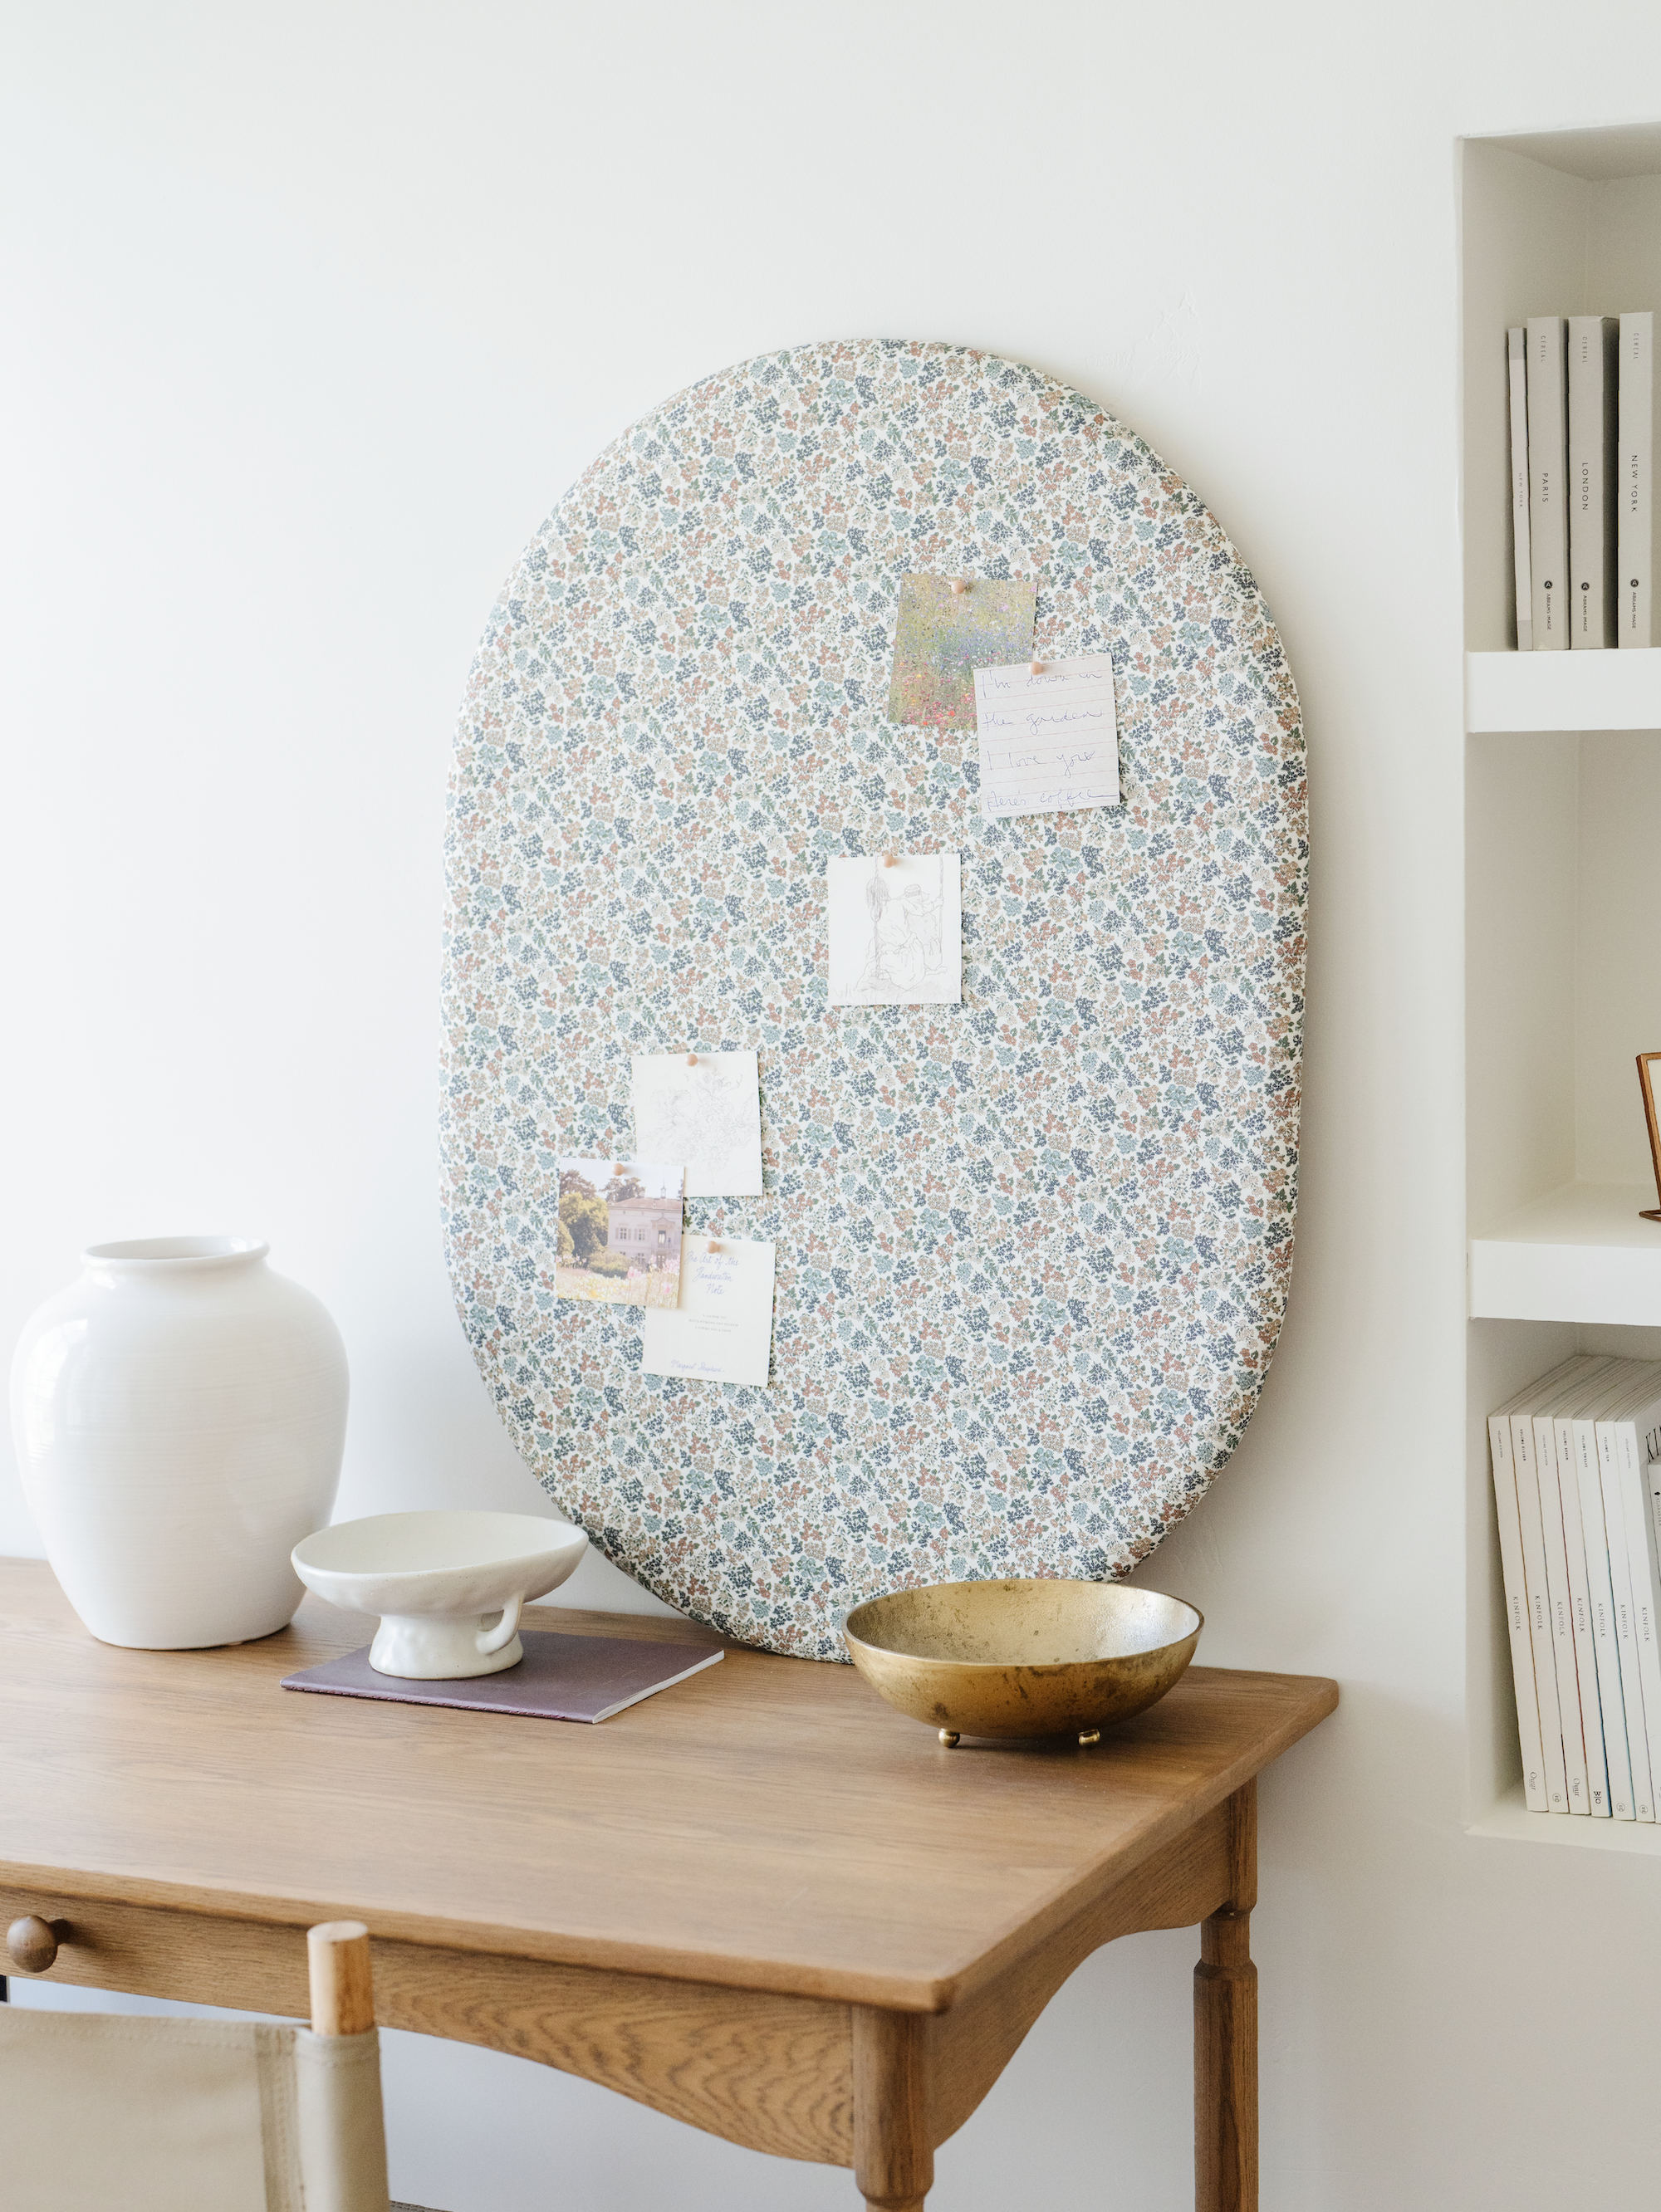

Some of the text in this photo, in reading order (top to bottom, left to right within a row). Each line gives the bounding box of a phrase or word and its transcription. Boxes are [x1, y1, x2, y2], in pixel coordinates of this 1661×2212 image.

[982, 670, 1011, 699] I'm
[1026, 673, 1071, 688] down
[982, 709, 1102, 735] the garden
[987, 751, 992, 771] I
[1008, 752, 1046, 768] love
[1040, 786, 1119, 809] coffee
[684, 1250, 739, 1270] The Art of the
[692, 1266, 733, 1283] Handwritten
[706, 1283, 725, 1294] Note
[1512, 1596, 1521, 1631] KINFOLK
[1535, 1595, 1543, 1630] KINFOLK
[1598, 1603, 1606, 1637] KINFOLK
[1620, 1604, 1629, 1639] KINFOLK
[1642, 1607, 1650, 1642] KINFOLK
